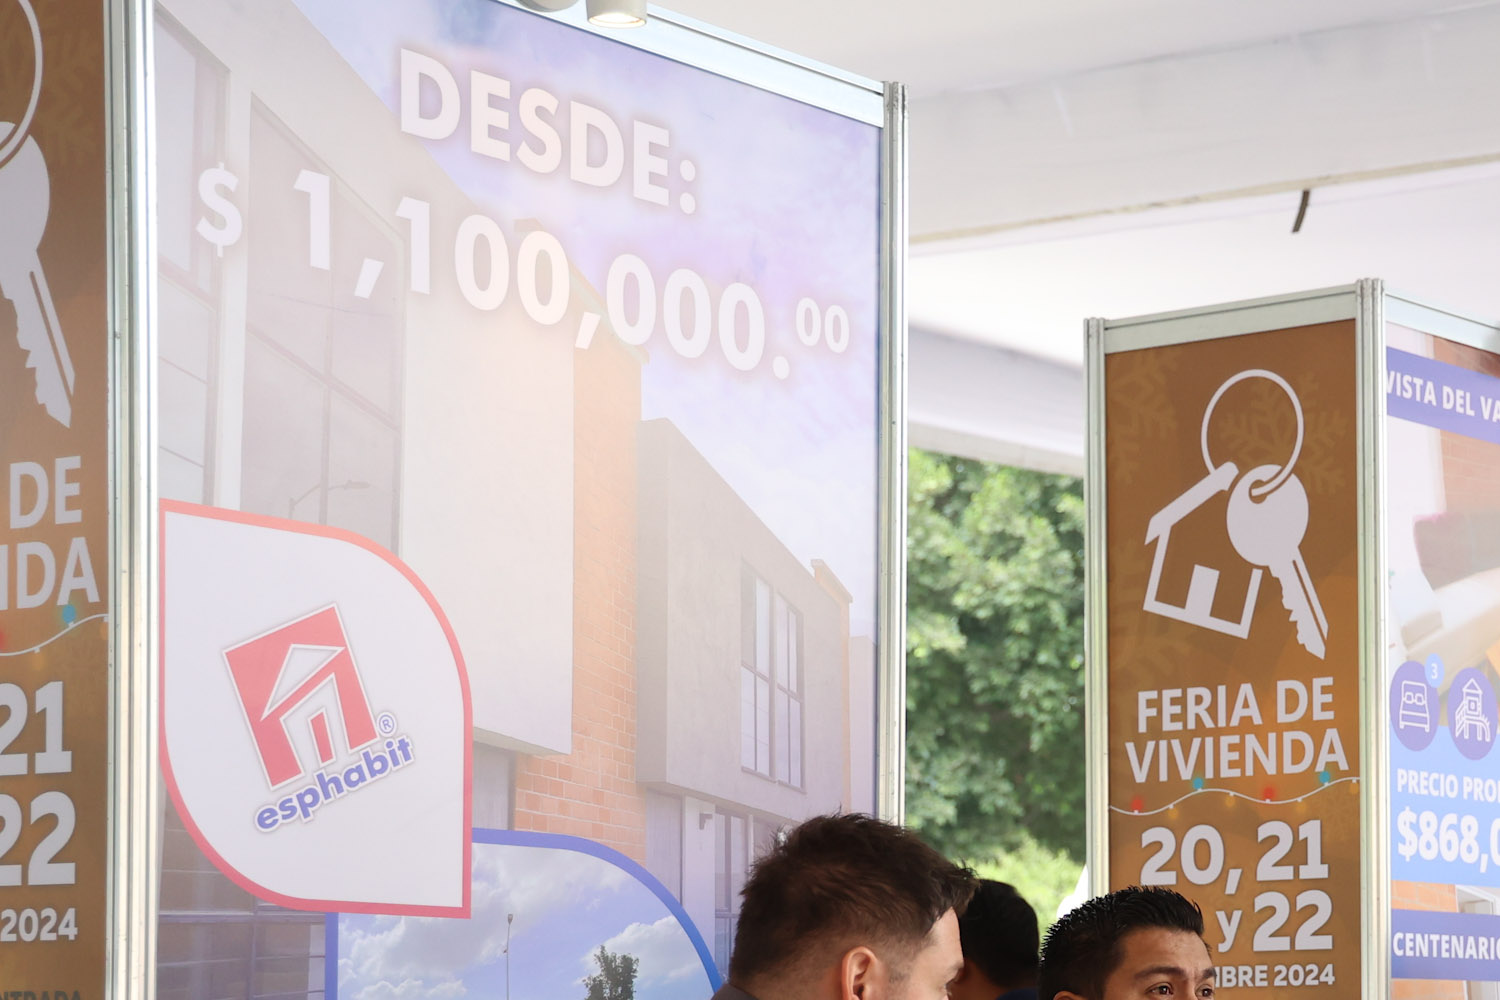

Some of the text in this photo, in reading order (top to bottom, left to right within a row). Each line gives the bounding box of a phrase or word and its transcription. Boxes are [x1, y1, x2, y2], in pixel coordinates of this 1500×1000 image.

[401, 48, 697, 215] DESDE:
[196, 161, 243, 257] $
[1386, 371, 1437, 406] VISTA
[1442, 386, 1475, 417] DEL
[10, 456, 82, 529] DE
[1138, 676, 1335, 734] FERIA DE
[257, 738, 412, 829] esphabit
[1125, 728, 1349, 783] VIVIENDA
[1397, 768, 1458, 798] PRECIO
[1140, 819, 1328, 895] 20, 21
[0, 907, 78, 942] 2024
[1215, 889, 1333, 953] y 22
[1274, 964, 1335, 987] 2024
